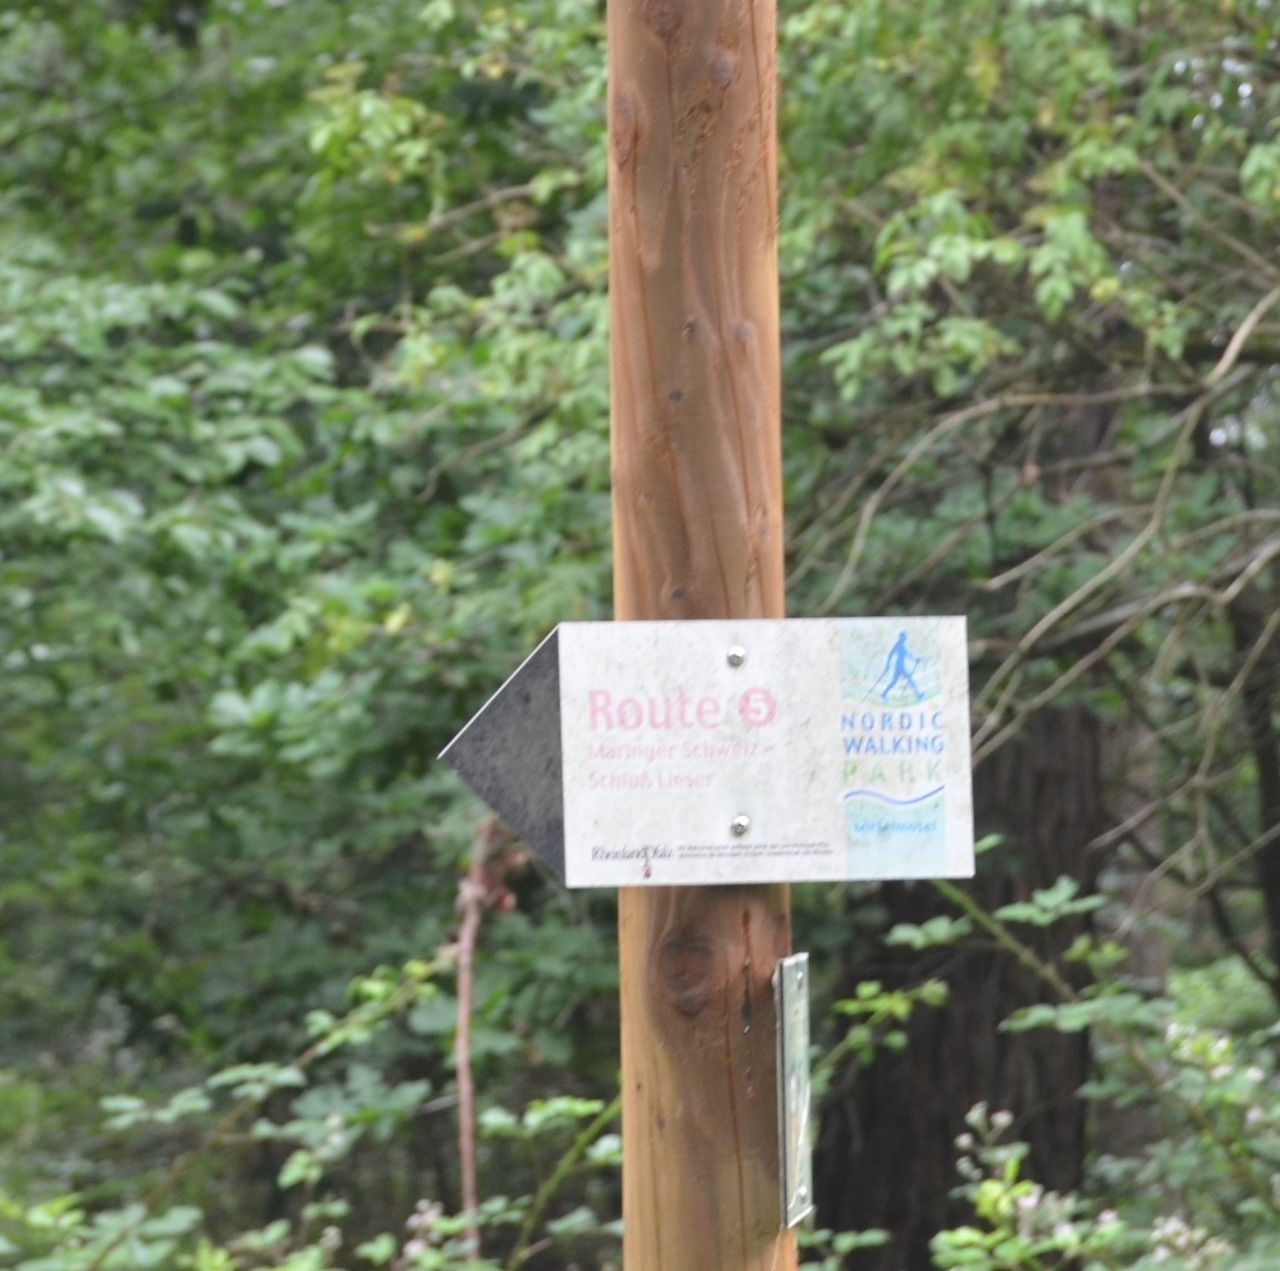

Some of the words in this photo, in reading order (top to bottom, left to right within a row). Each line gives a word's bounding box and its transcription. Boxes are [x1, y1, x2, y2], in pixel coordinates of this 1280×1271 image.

[587, 689, 722, 731] Route
[841, 711, 944, 731] NORDIC
[843, 734, 945, 755] WALKING
[842, 759, 943, 784] PARK
